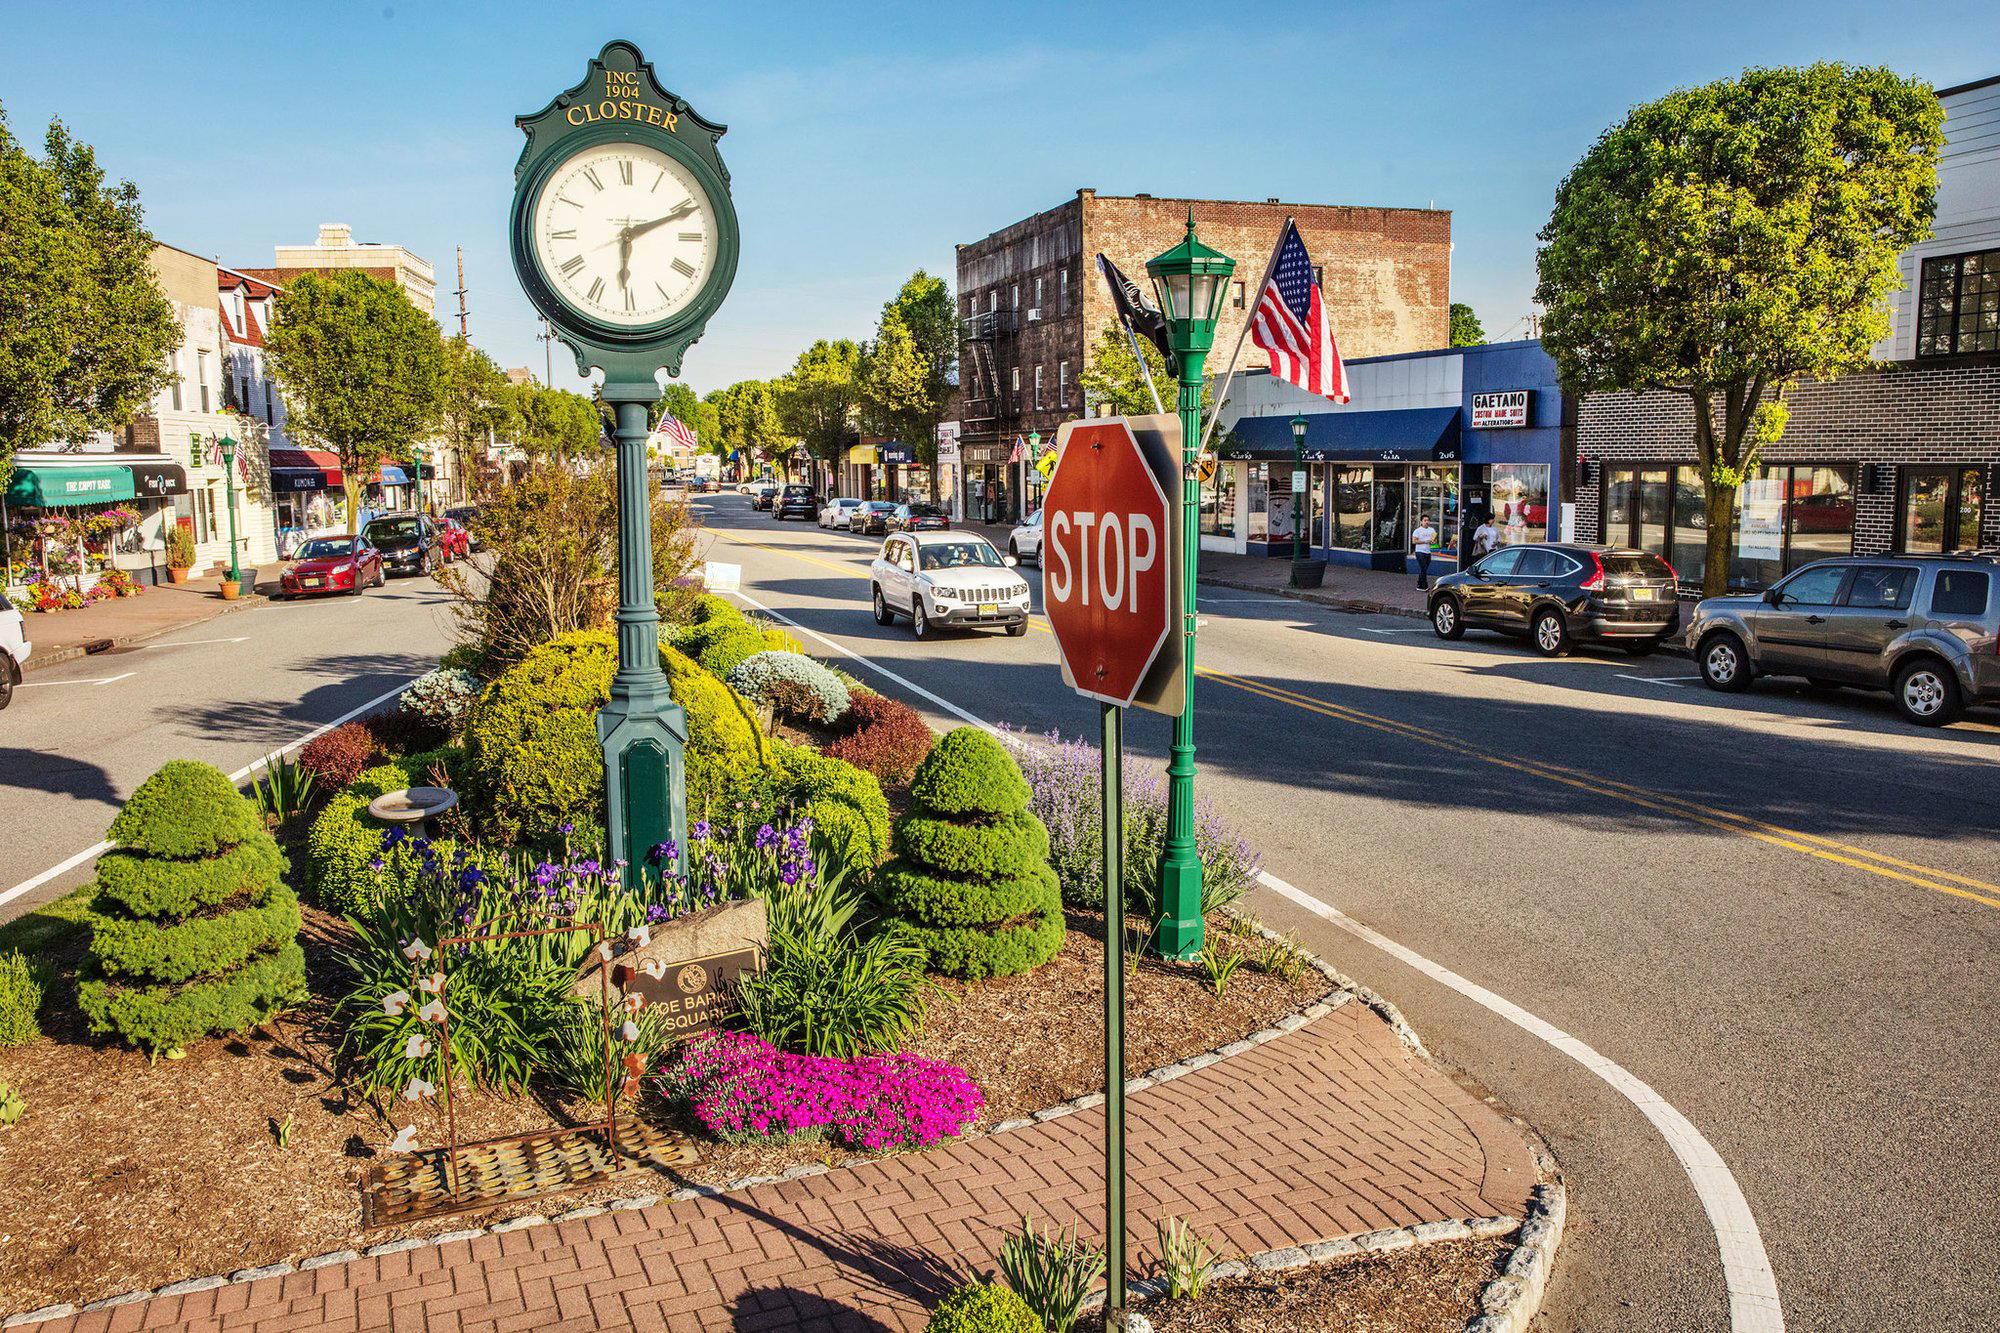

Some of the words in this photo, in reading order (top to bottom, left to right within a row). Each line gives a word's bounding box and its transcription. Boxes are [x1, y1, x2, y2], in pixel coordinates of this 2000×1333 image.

[606, 71, 640, 85] INC.
[606, 86, 639, 98] 1904
[566, 101, 678, 133] CLOSTER
[1474, 393, 1524, 408] GAETANO
[1051, 510, 1156, 613] STOP
